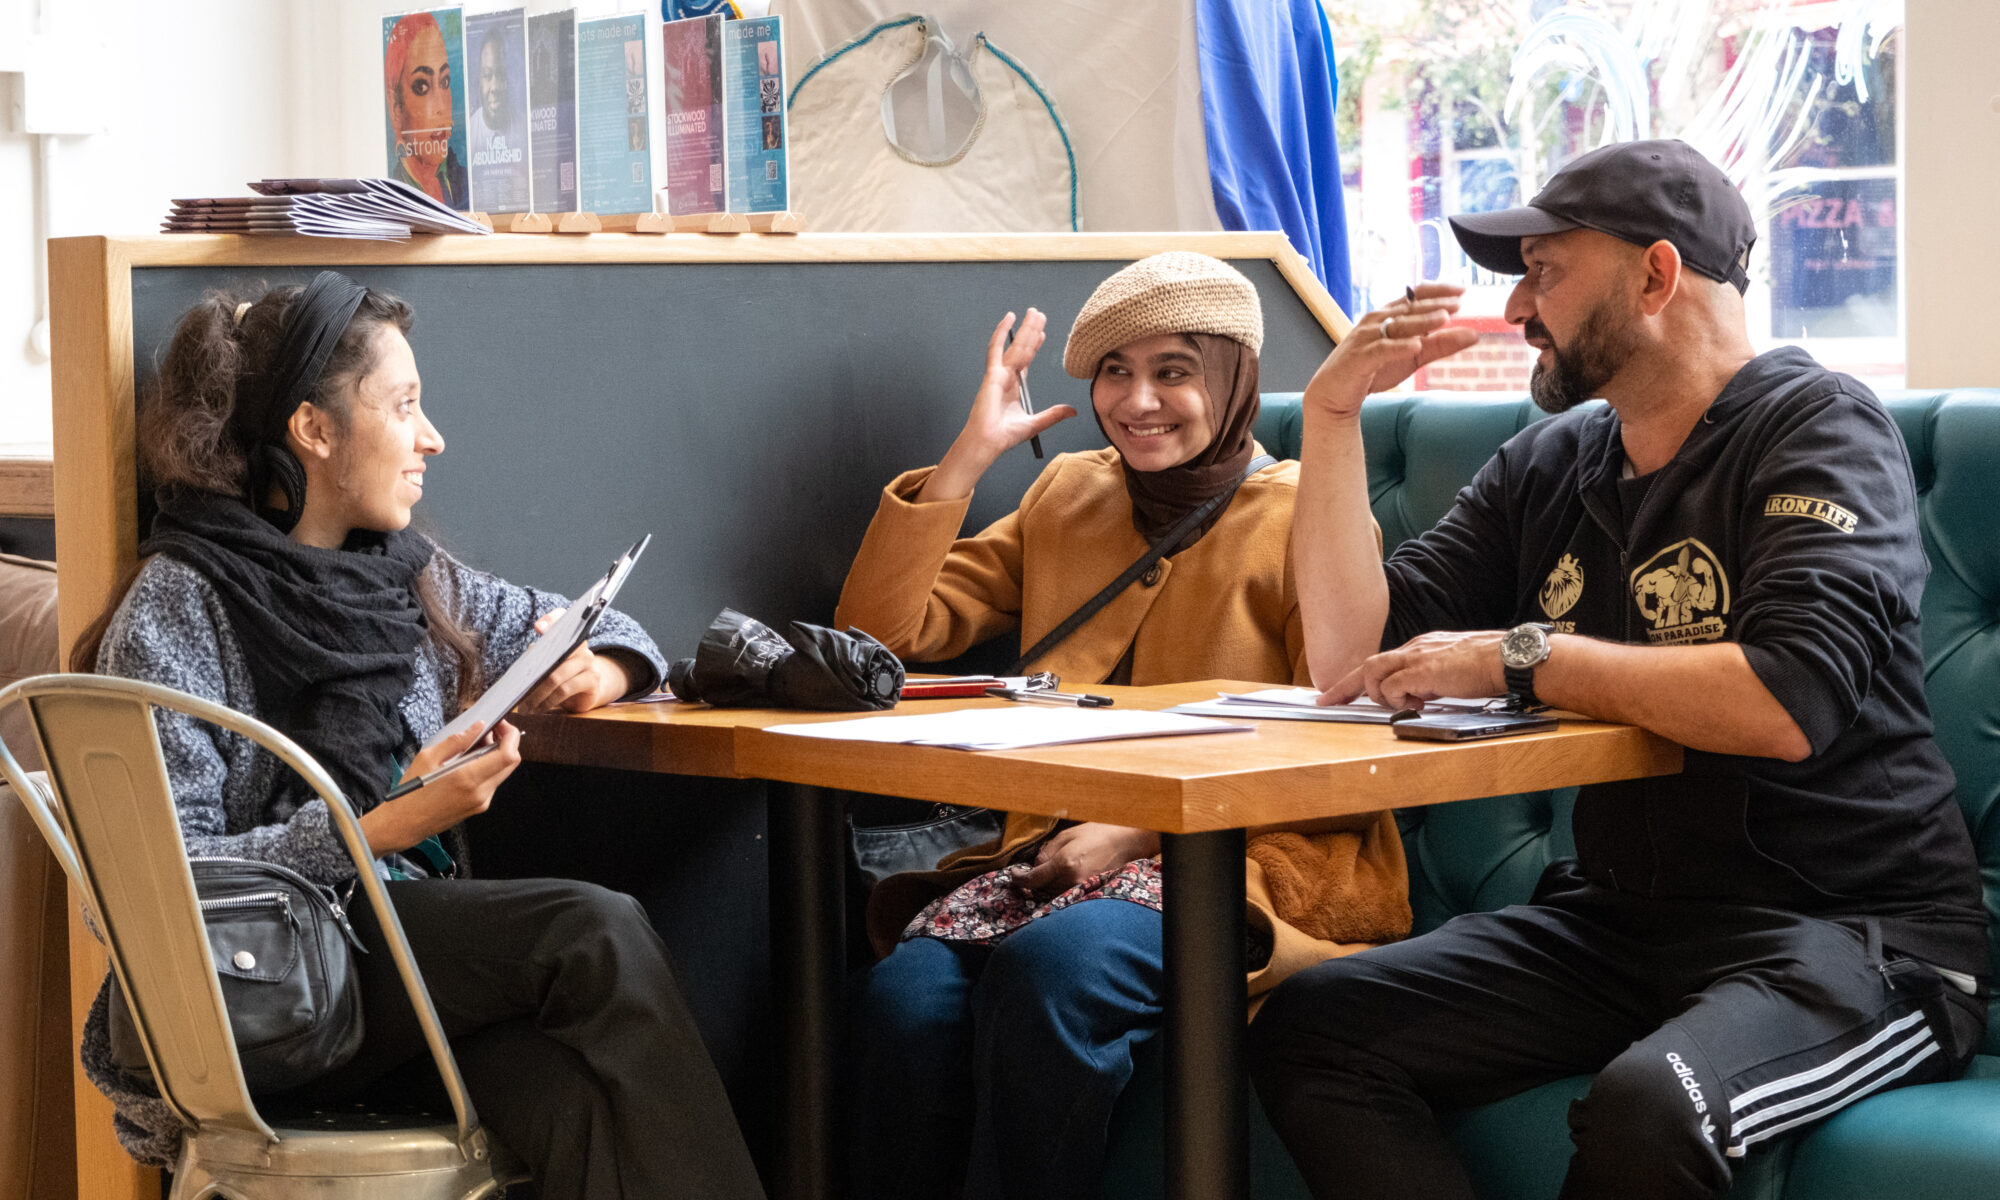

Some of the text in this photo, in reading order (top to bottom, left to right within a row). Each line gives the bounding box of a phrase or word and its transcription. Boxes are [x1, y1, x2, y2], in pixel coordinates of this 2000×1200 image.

[598, 24, 622, 39] made
[624, 24, 637, 36] me
[729, 25, 771, 40] made me
[531, 107, 556, 120] KWOOD
[668, 110, 705, 124] STOCKWOOD
[668, 121, 706, 136] ILLUMINATED
[406, 137, 449, 158] strong
[487, 136, 507, 150] NABIL
[1781, 198, 1863, 228] PIZZA
[1764, 498, 1857, 529] IRON LIFE
[1548, 621, 1576, 633] ONS
[1664, 623, 1720, 640] PARADISE
[1666, 1052, 1708, 1114] adidas
